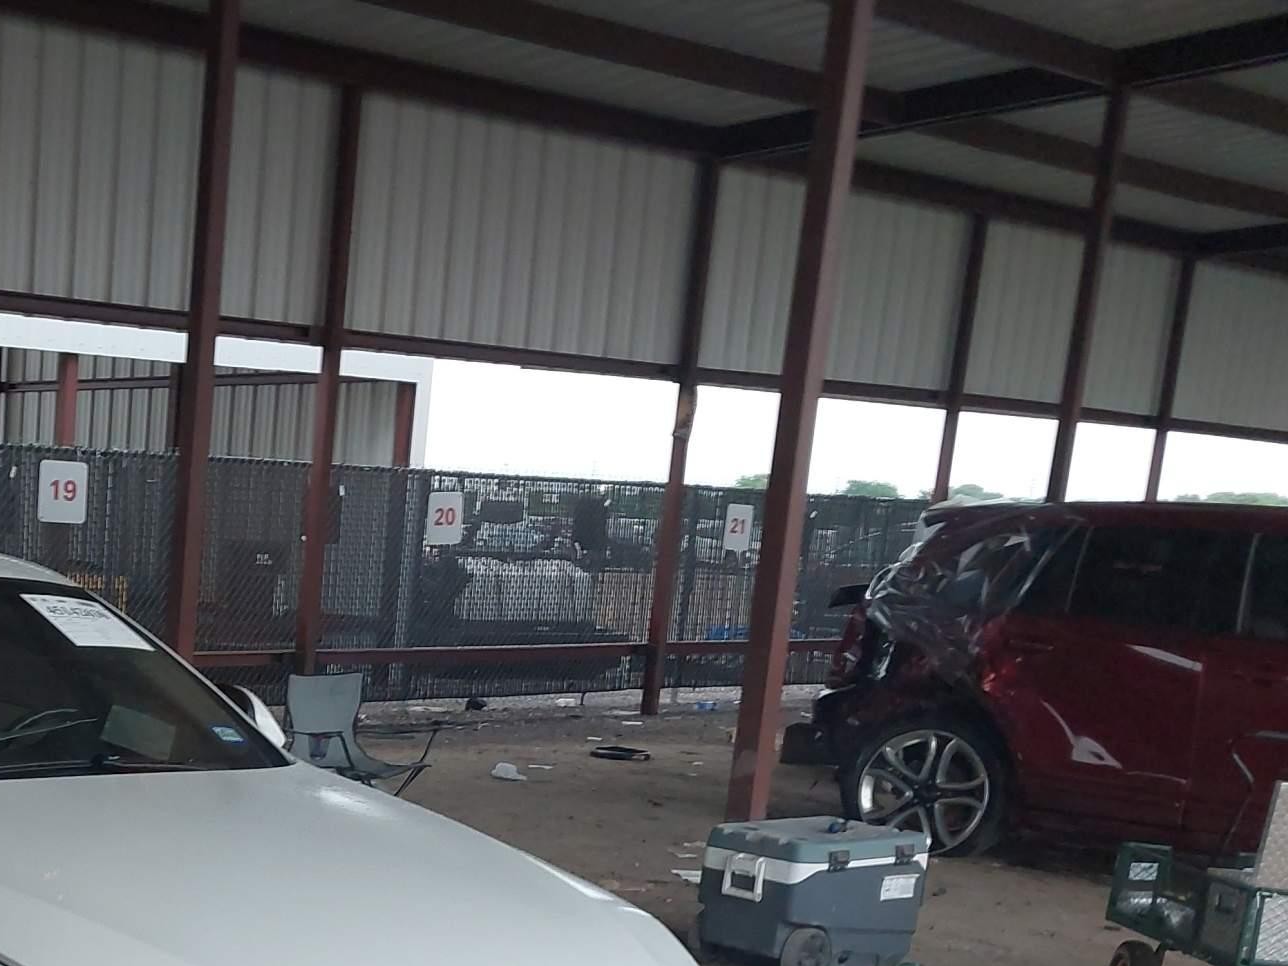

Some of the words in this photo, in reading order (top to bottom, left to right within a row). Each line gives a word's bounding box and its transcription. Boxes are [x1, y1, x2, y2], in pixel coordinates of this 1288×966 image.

[50, 479, 77, 502] 19
[434, 507, 455, 526] 20
[729, 518, 745, 534] 21
